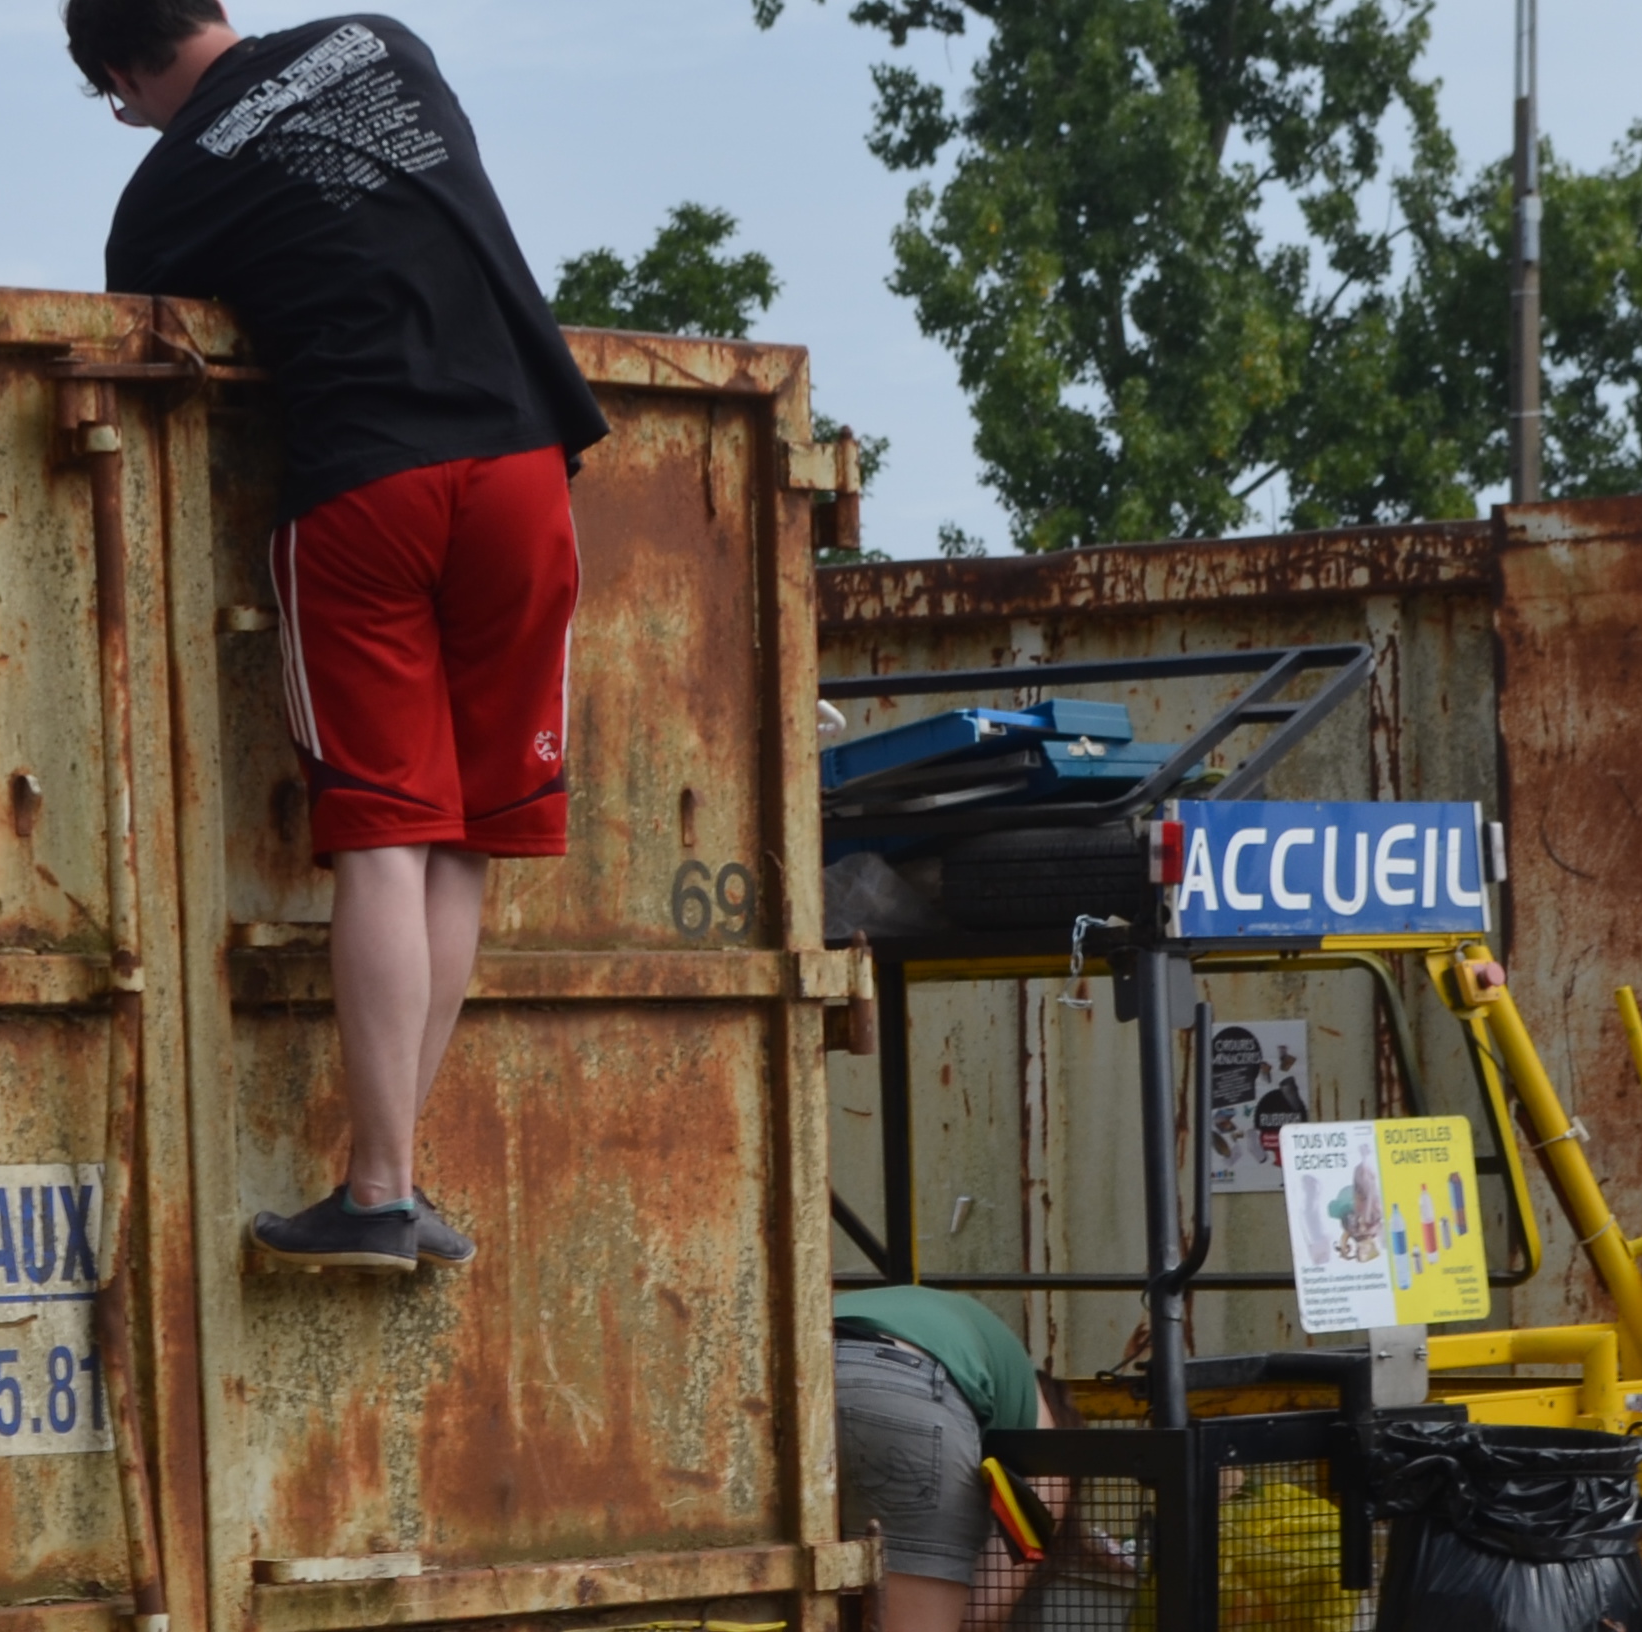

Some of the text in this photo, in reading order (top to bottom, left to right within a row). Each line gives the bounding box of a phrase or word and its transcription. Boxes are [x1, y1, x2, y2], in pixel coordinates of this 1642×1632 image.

[1177, 823, 1482, 916] ACCUEIL
[671, 859, 756, 941] 69
[1292, 1133, 1322, 1150] TOUS
[1324, 1132, 1347, 1148] VOS
[1384, 1126, 1452, 1146] BOUTEILLES
[1294, 1150, 1349, 1171] DÉCHETS
[1391, 1146, 1450, 1165] CANETTES
